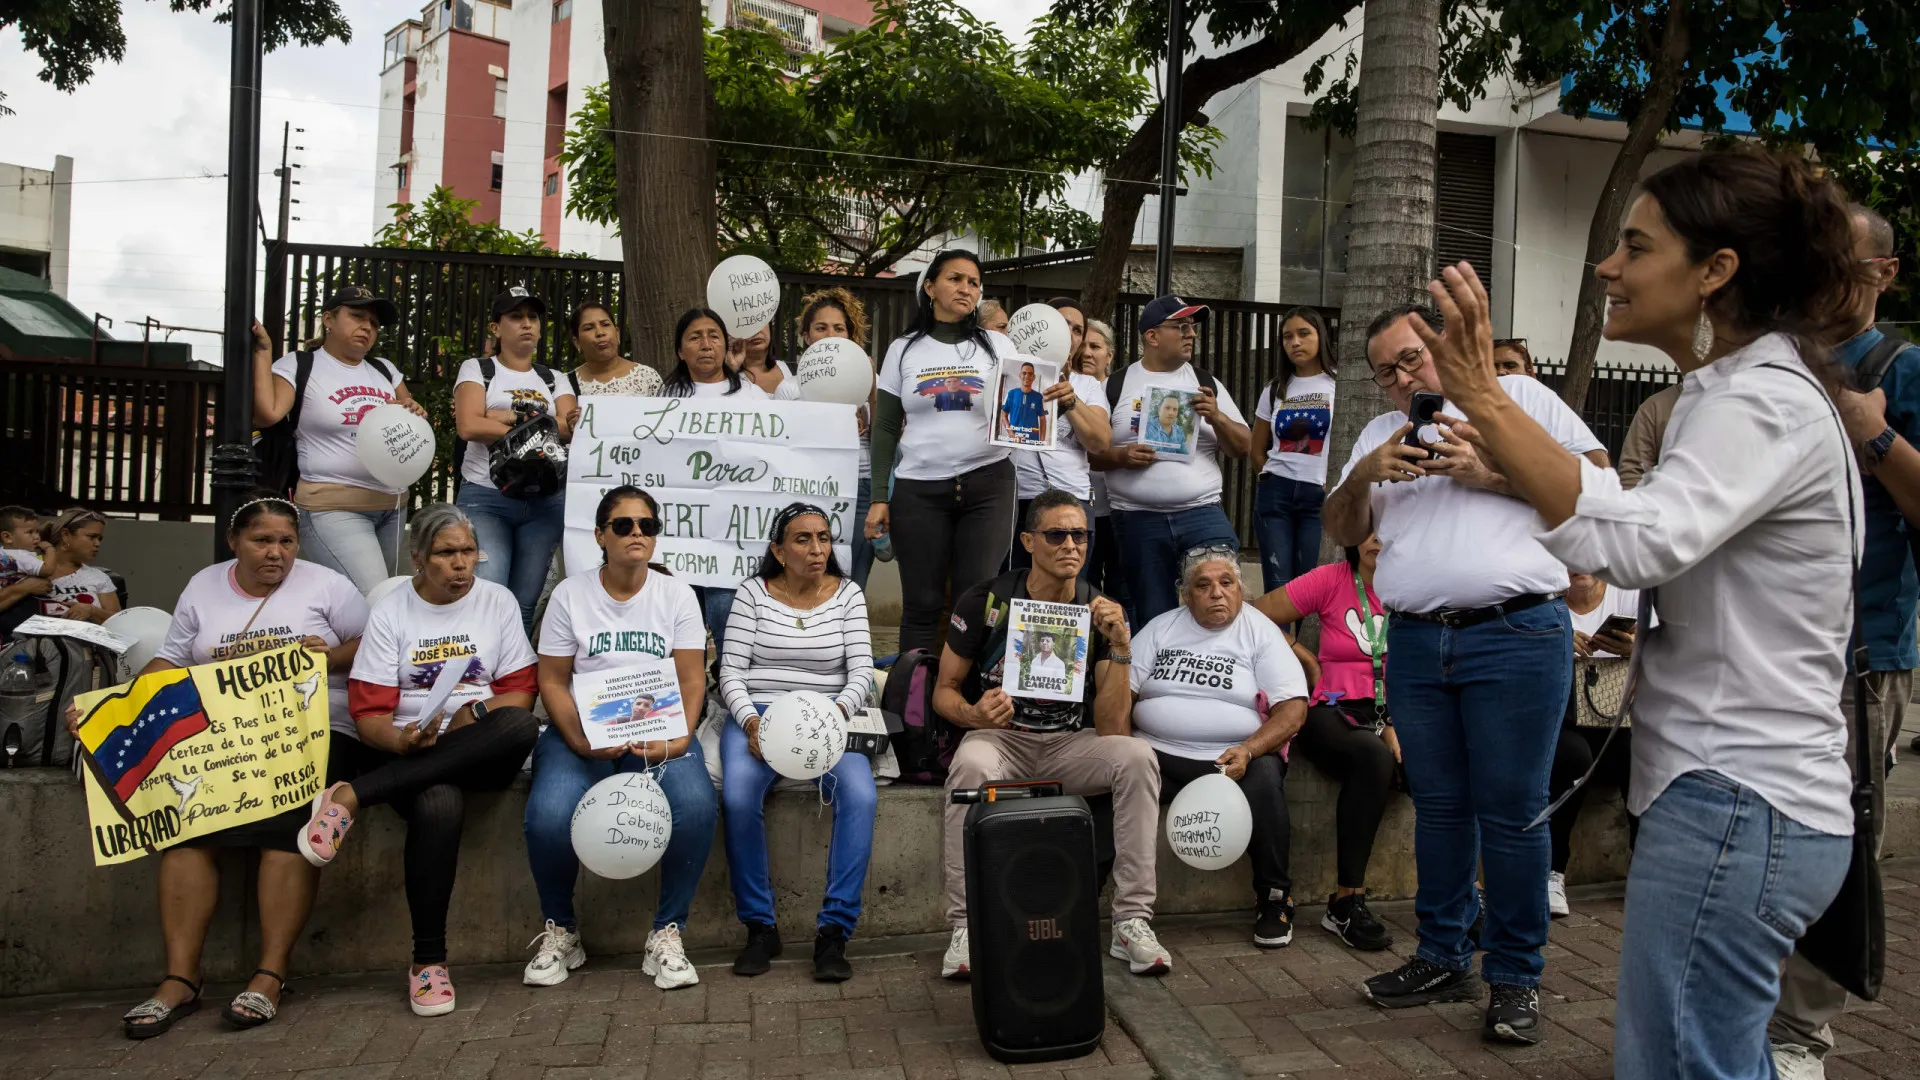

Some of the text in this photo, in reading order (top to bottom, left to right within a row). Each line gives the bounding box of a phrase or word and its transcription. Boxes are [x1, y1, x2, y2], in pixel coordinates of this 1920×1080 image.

[800, 366, 837, 386] LIBERTAD
[915, 371, 946, 379] ROBERT
[920, 365, 957, 373] LIBERTAD
[579, 398, 790, 445] A LIBERTAD.
[581, 440, 769, 483] 1 año Para
[620, 472, 839, 497] DE SU DETENCIÓN
[662, 551, 719, 575] FORMA
[1034, 608, 1083, 618] DELINCUENTE
[1044, 604, 1089, 614] TERRORISTA
[1020, 614, 1078, 628] LIBERTAD
[220, 625, 293, 645] LIBERTAD PARA
[418, 634, 471, 648] LIBERTAD PARA
[588, 630, 666, 659] LOS ANGELES
[412, 643, 478, 662] JOSÉ SALAS
[1156, 648, 1194, 658] LIBEREN
[215, 645, 315, 701] HEBREOS
[1177, 657, 1234, 676] PRESOS
[605, 669, 663, 685] LIBERTAD PARA
[607, 676, 664, 692] DANNY RAFAEL
[1147, 667, 1233, 690] POLÍTICOS
[259, 688, 286, 709] 11:1
[597, 681, 676, 701] SOTOMAYOR CEDEÑO
[209, 720, 227, 735] Es
[234, 716, 259, 730] Pues
[282, 707, 295, 720] fe
[631, 725, 668, 737] terrorista
[168, 743, 215, 761] Certeza
[220, 737, 235, 751] de
[260, 730, 281, 748] que
[203, 751, 258, 773] Convicción
[264, 747, 279, 760] de
[310, 729, 326, 741] no
[274, 760, 316, 790] PRESOS
[607, 790, 671, 823] Diosdado
[616, 811, 665, 836] Cabello
[1173, 811, 1220, 828] LIBERTAD
[94, 804, 182, 858] LIBERTAD
[182, 803, 230, 826] Para
[604, 827, 650, 851] Danny
[1028, 918, 1063, 941] JBL
[1425, 972, 1452, 988] balance
